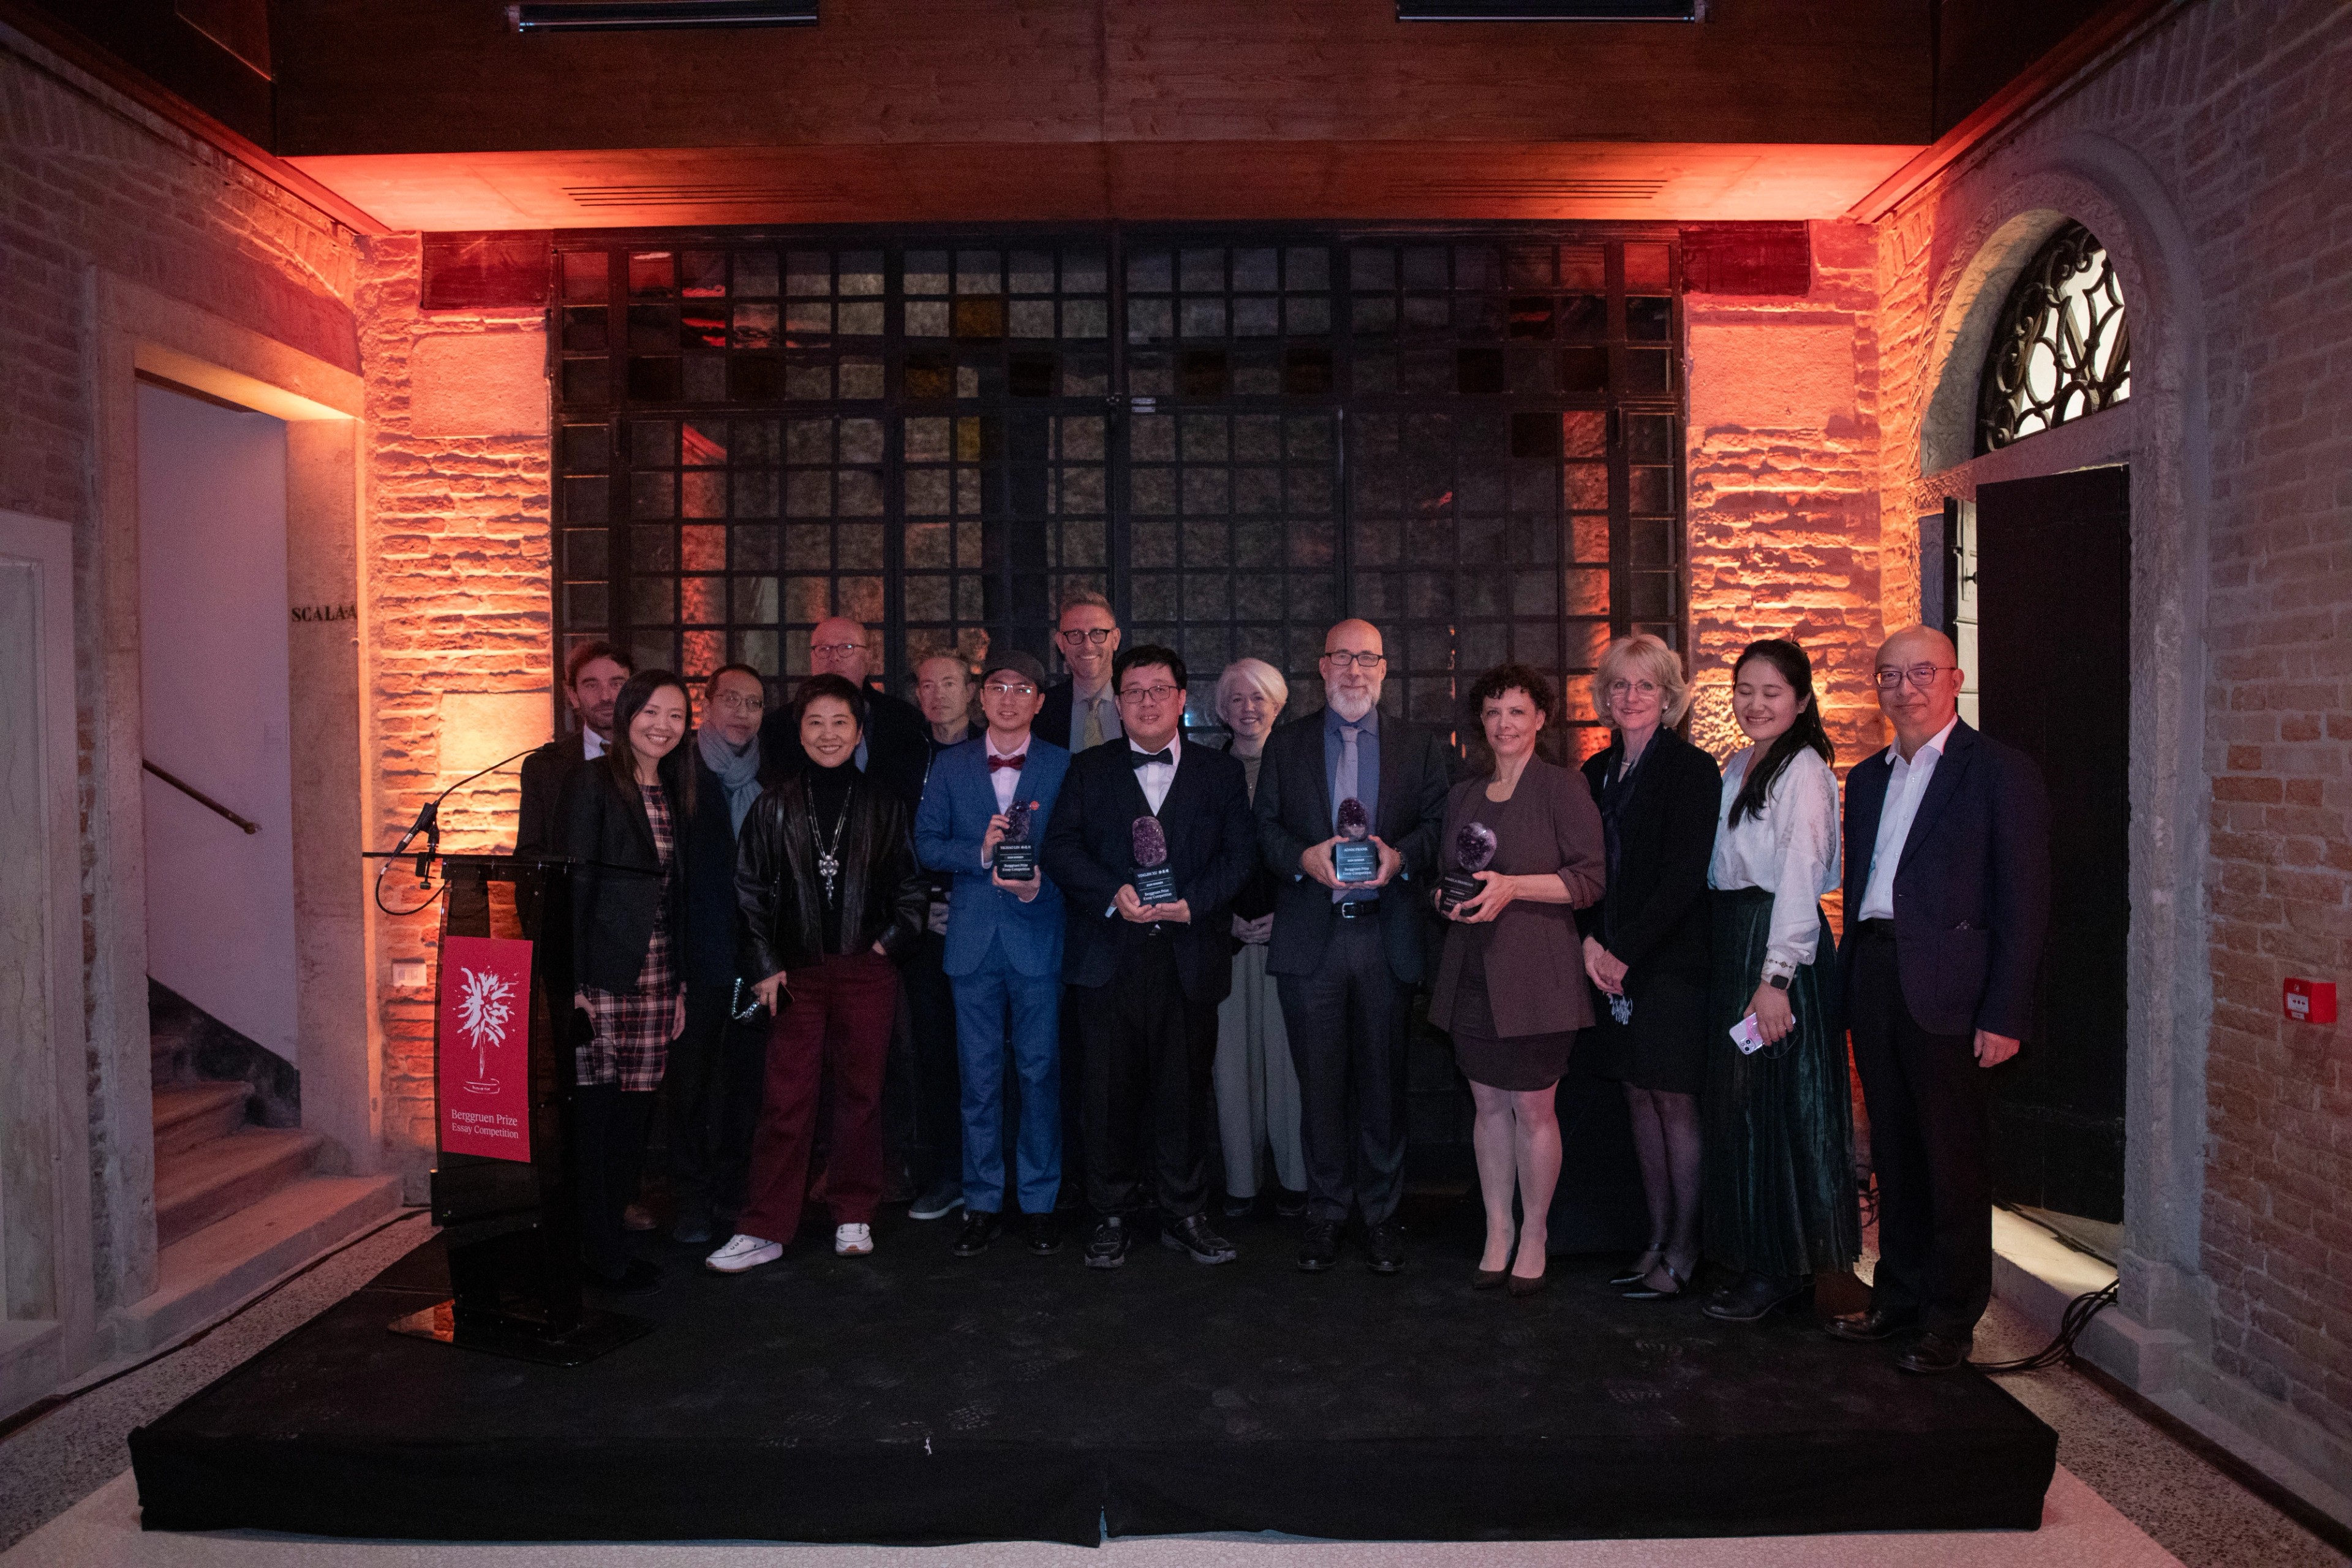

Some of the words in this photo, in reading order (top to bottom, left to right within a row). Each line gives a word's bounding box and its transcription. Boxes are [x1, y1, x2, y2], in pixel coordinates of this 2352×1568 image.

[451, 1108, 494, 1123] Berggruen
[496, 1114, 518, 1126] Prize
[451, 1122, 472, 1135] Essay
[474, 1125, 519, 1139] Competition
